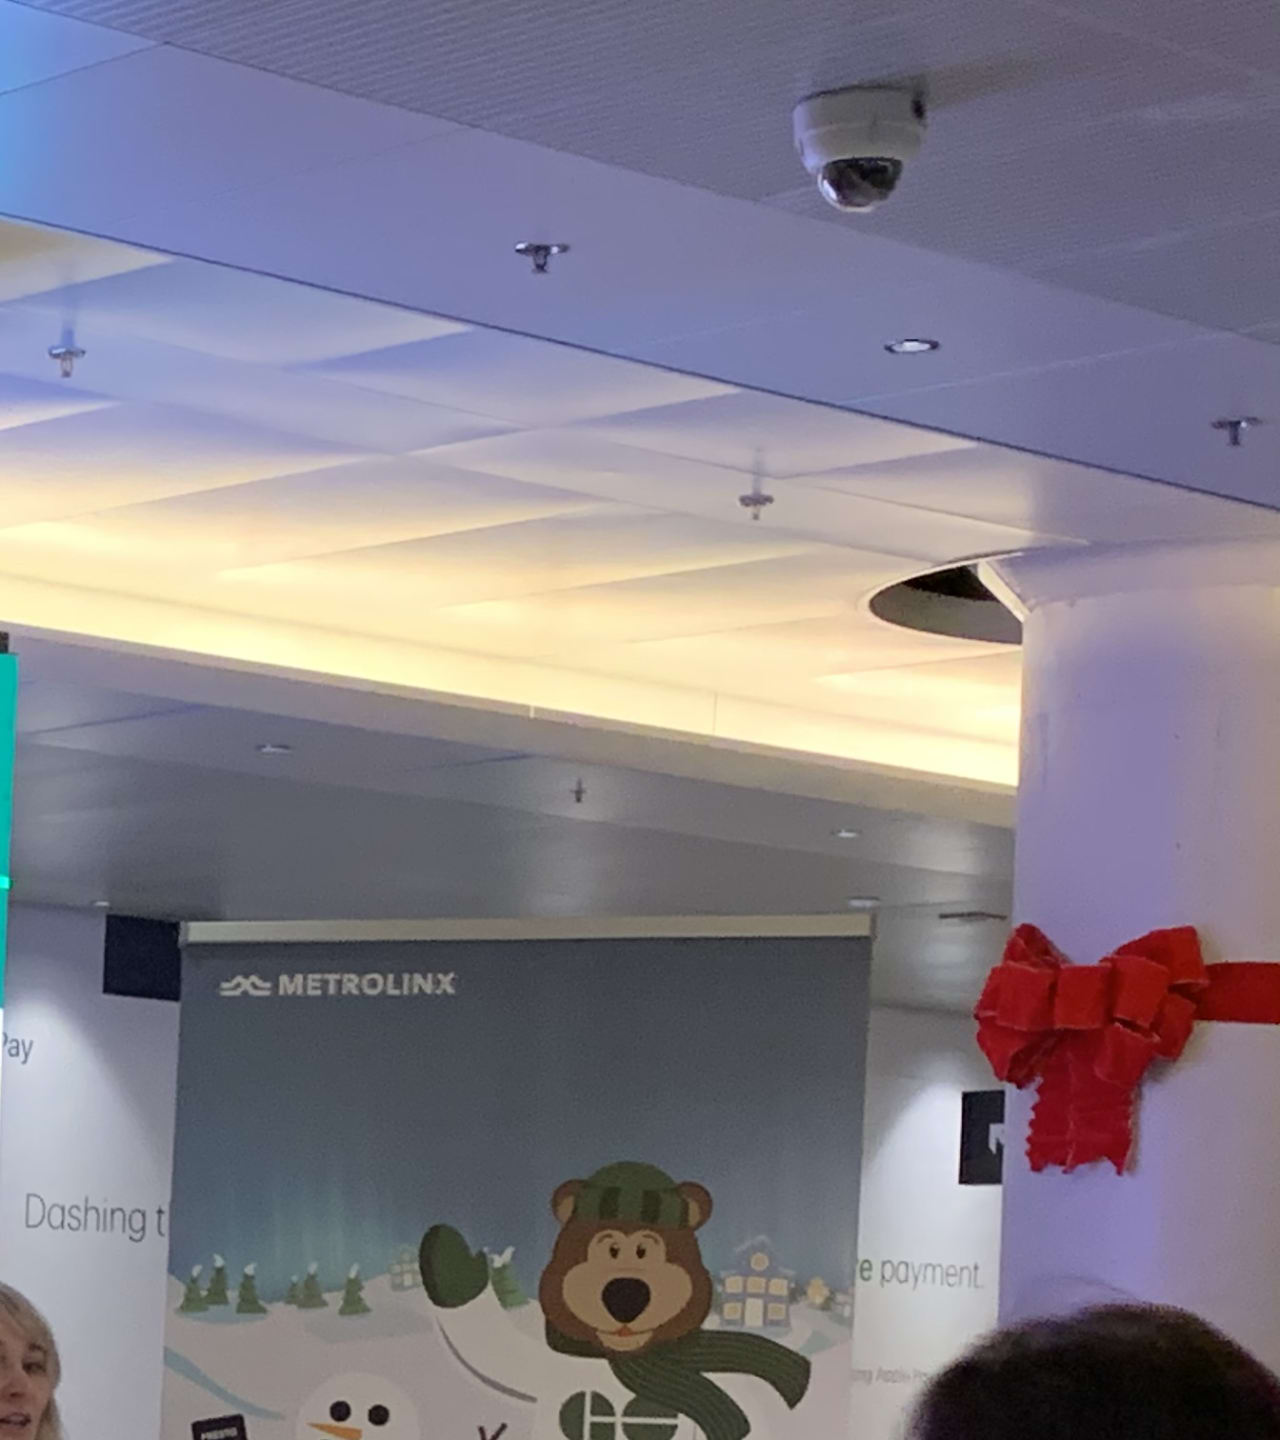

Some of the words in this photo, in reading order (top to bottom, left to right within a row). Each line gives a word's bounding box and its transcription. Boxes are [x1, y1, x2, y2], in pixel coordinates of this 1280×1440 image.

[278, 971, 456, 997] METROLINX
[25, 1192, 147, 1243] Dashing
[880, 1259, 985, 1292] payment.
